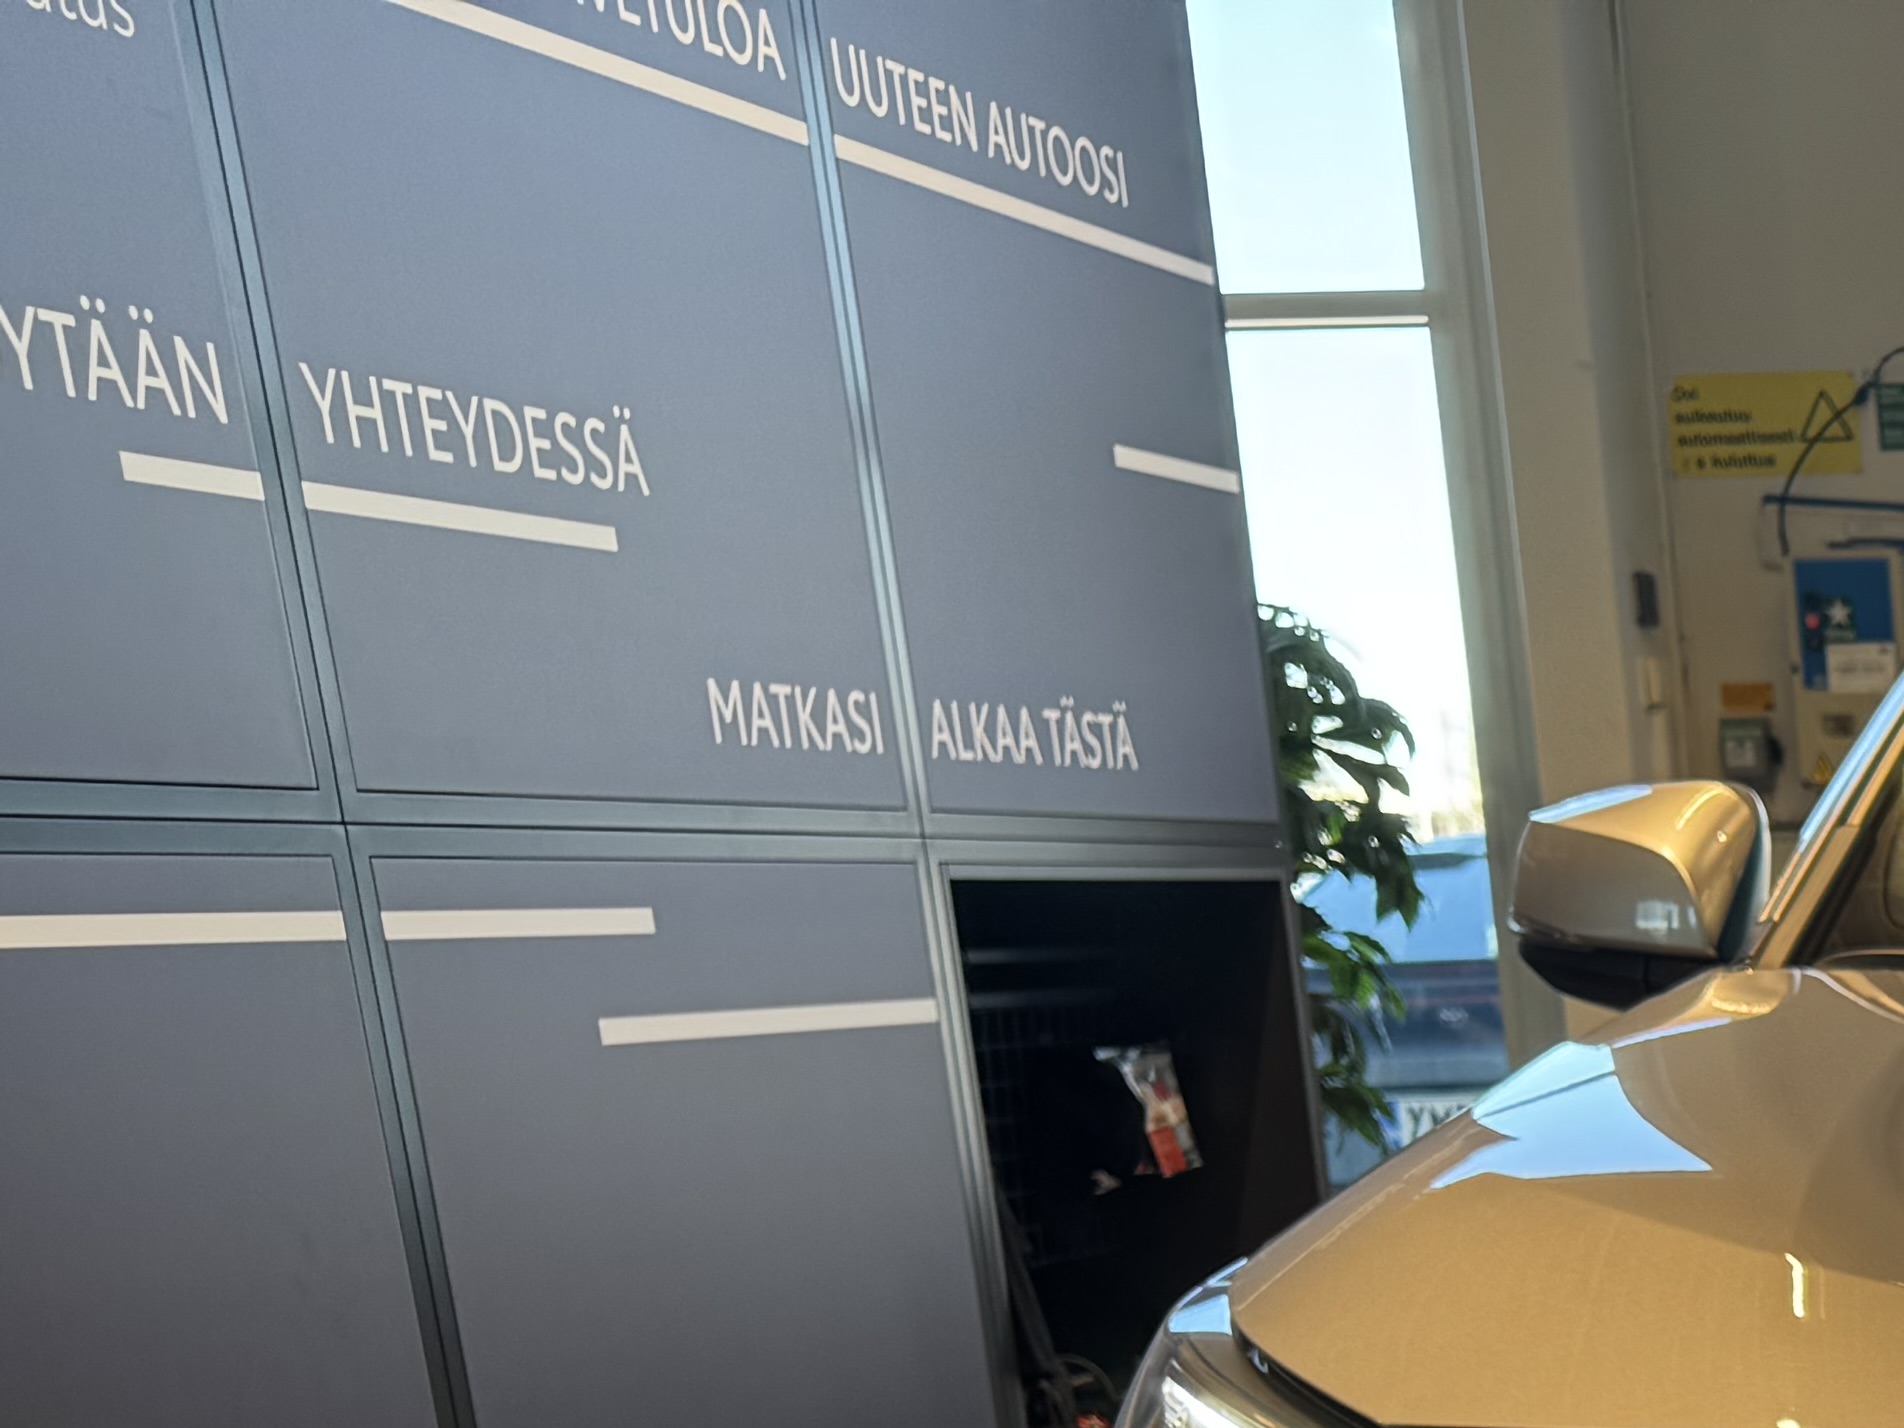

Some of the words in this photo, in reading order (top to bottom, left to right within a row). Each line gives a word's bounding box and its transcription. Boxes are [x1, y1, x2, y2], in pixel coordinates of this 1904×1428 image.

[830, 37, 978, 152] UUTEEN
[988, 101, 1128, 208] AUTOOSI
[299, 362, 650, 497] YHTEYDESSÄ
[707, 678, 884, 755] MATKASI
[931, 699, 1043, 766] ALKAA
[1042, 695, 1139, 771] TÄSTÄ
